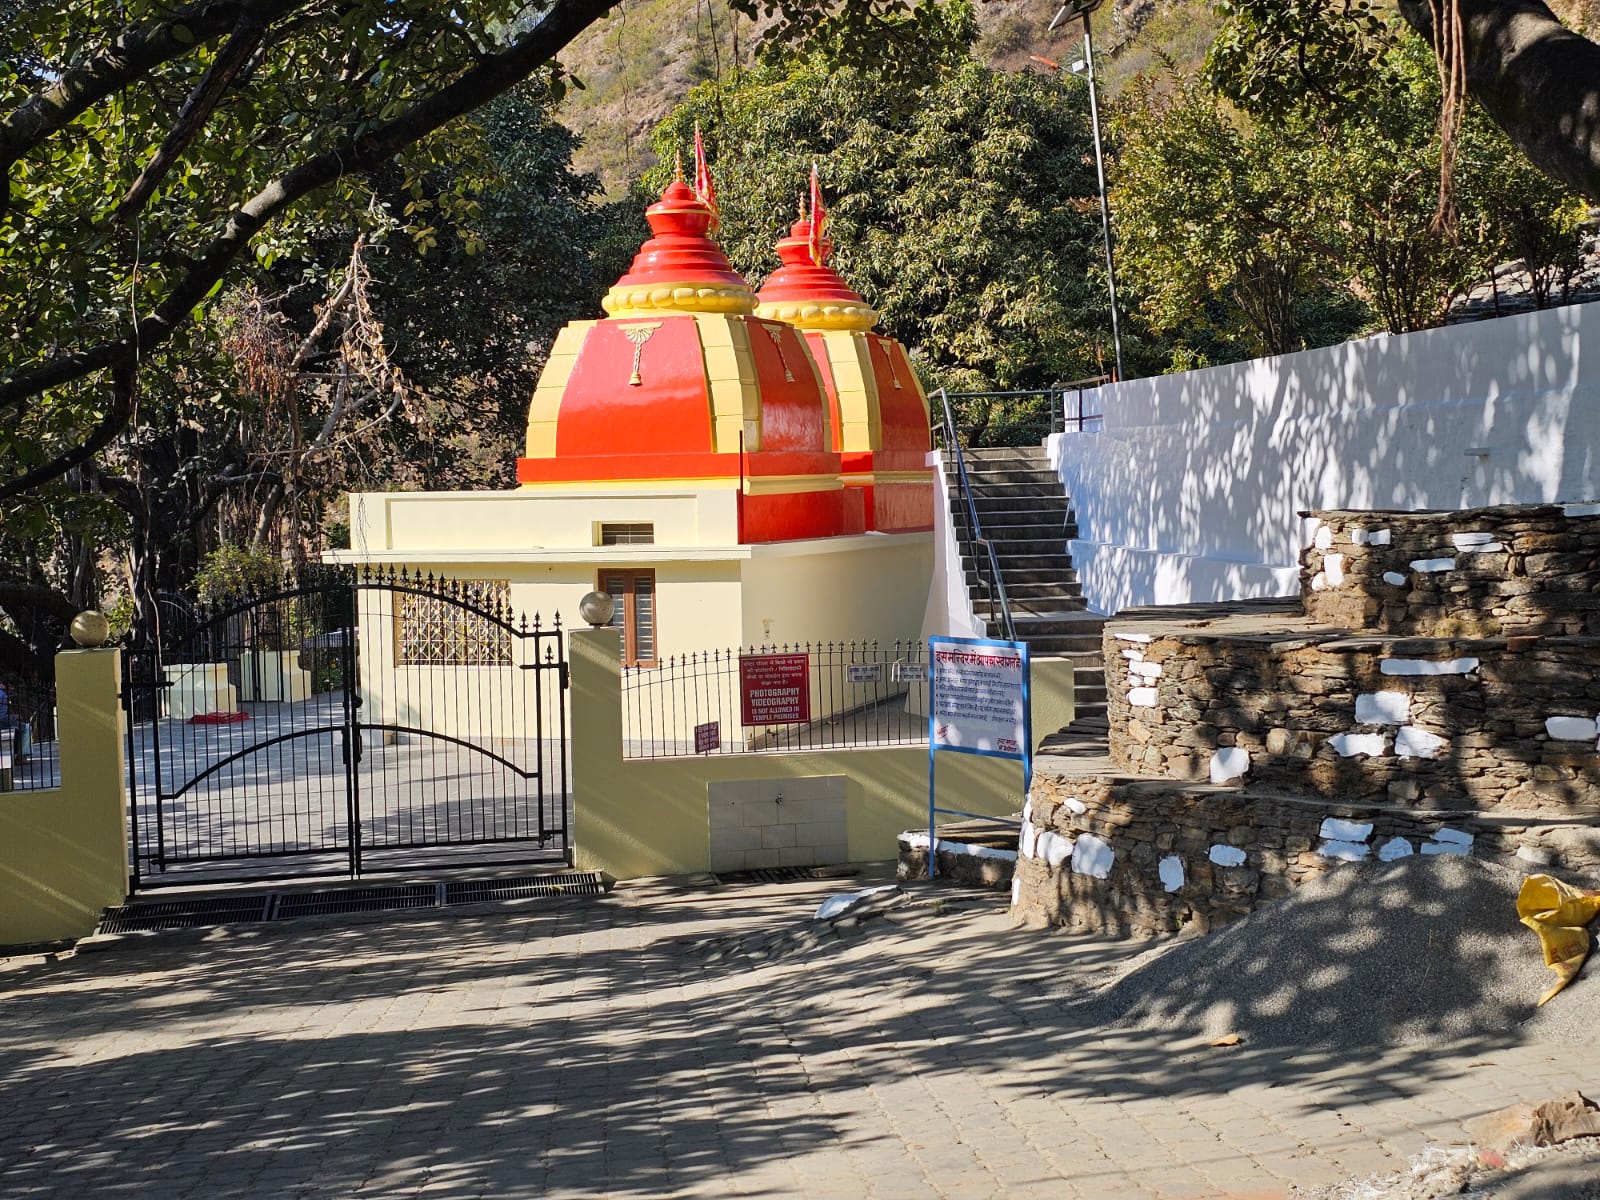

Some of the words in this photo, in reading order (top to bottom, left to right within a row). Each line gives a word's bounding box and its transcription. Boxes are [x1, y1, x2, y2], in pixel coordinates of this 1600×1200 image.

[750, 688, 800, 698] PHOTOGRAPHY
[751, 696, 799, 706] VIDEOGRAPHY
[769, 706, 793, 714] ALLOWED
